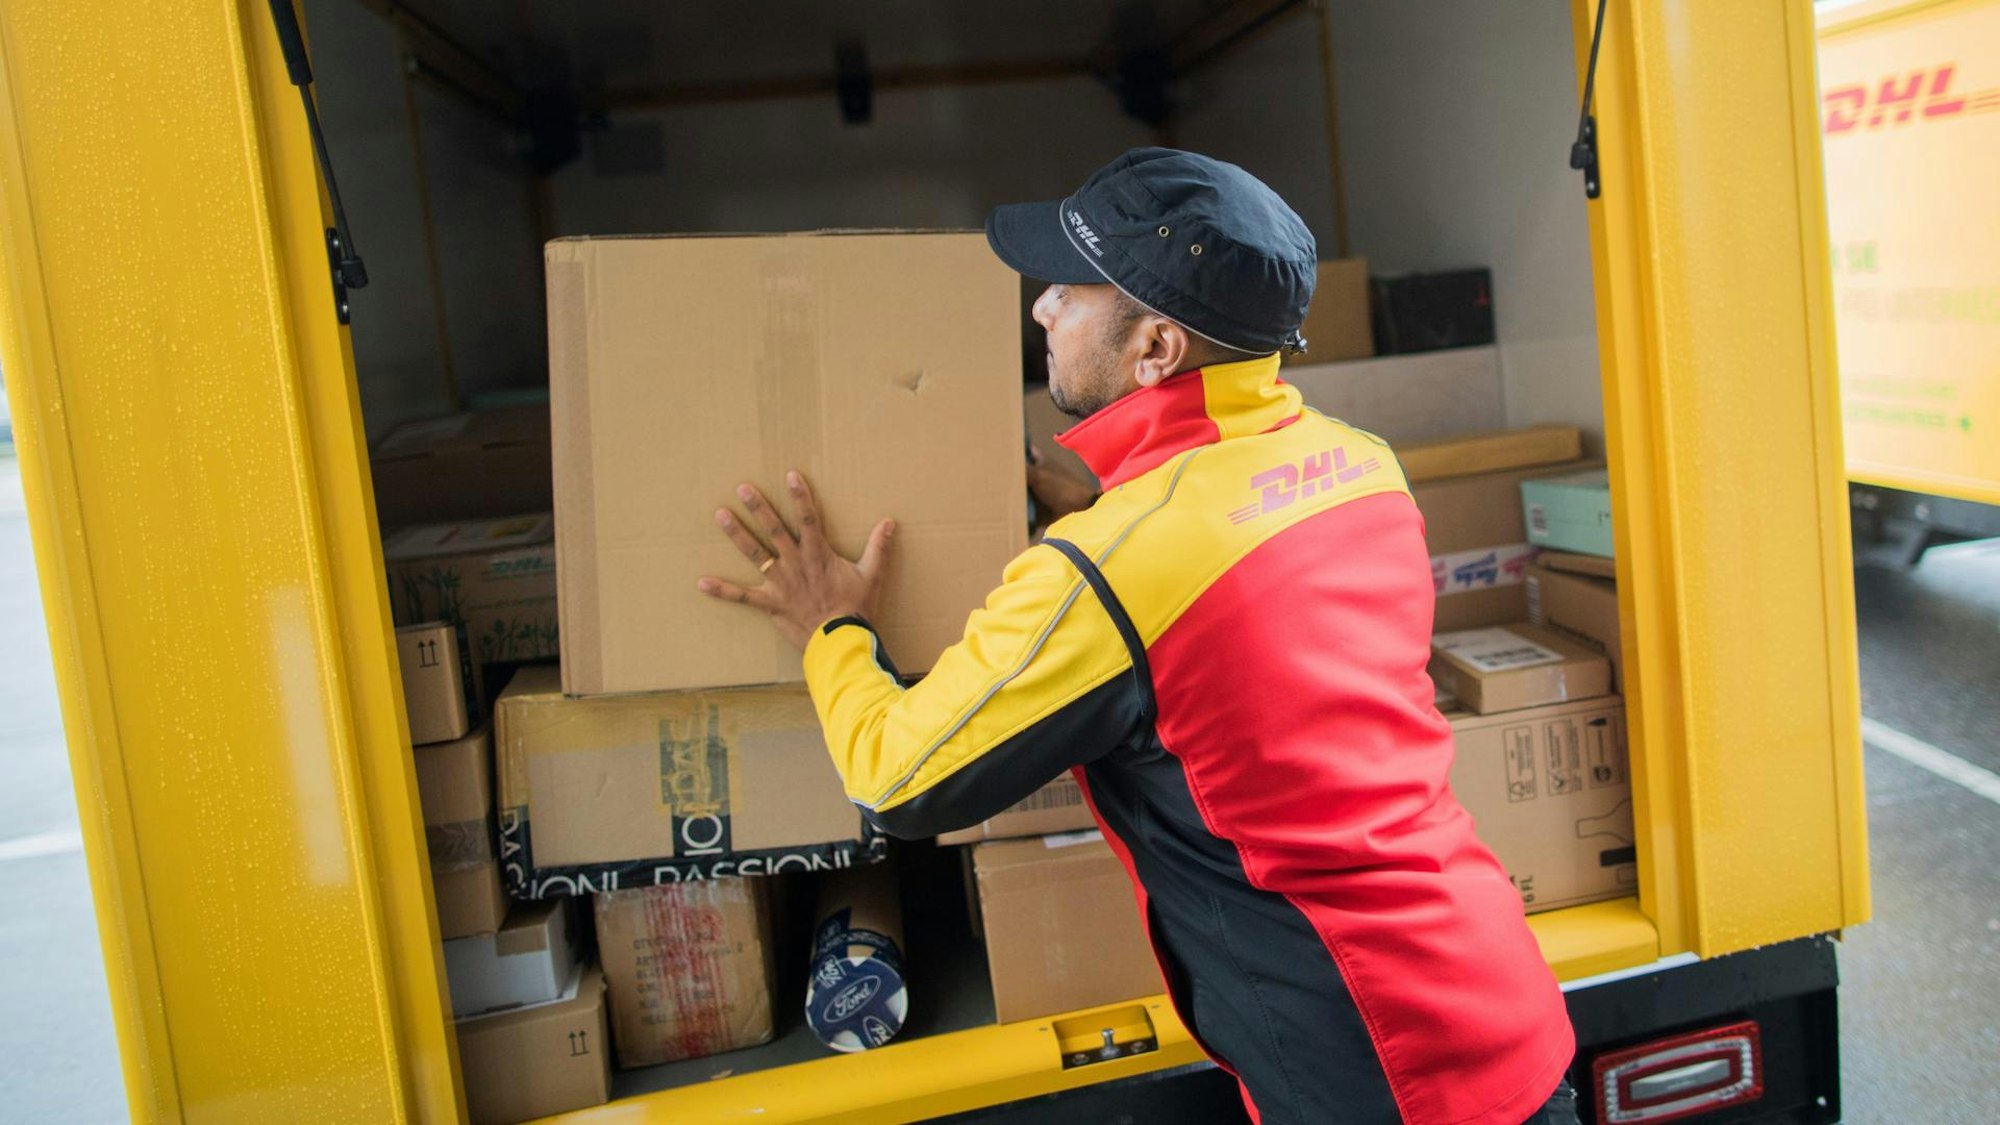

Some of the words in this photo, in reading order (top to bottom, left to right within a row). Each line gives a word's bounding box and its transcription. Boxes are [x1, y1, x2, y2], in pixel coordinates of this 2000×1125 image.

[1825, 67, 1965, 133] DHL
[1069, 211, 1101, 250] DHL
[1249, 446, 1364, 515] DHL
[835, 982, 872, 1017] Ford
